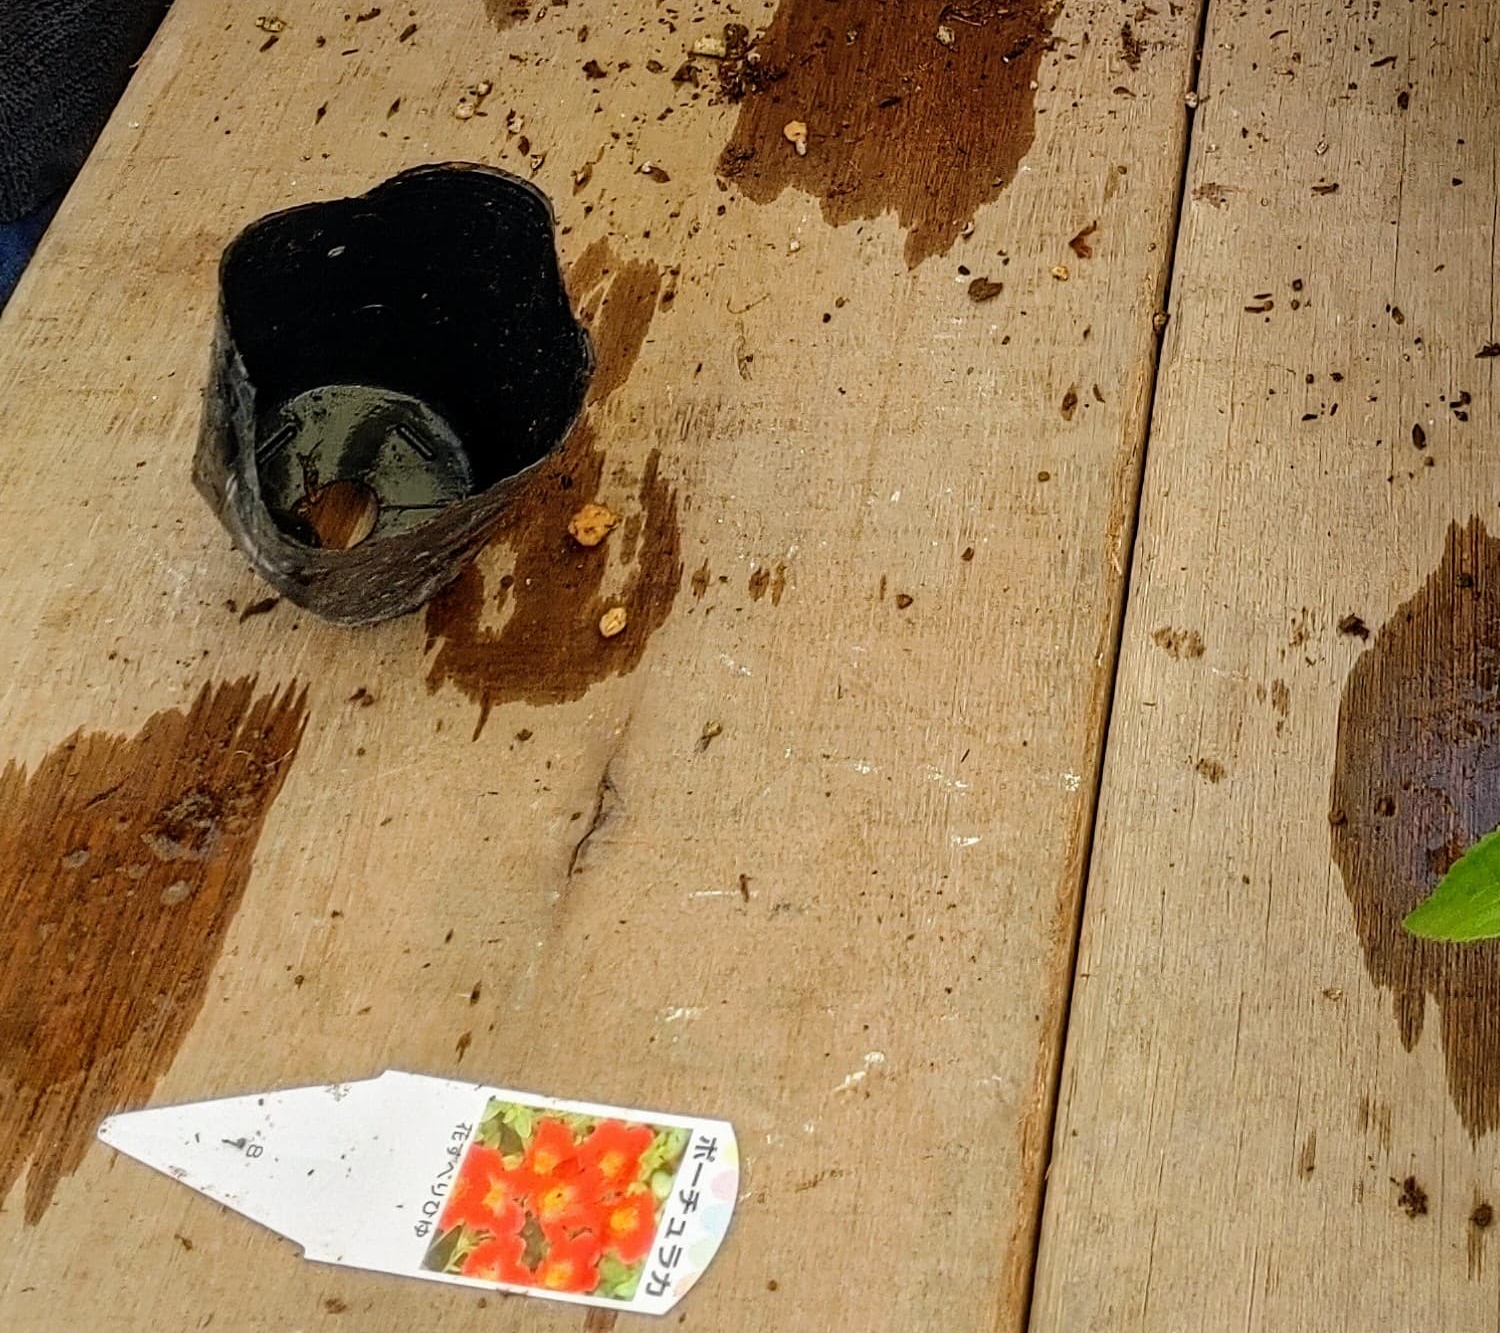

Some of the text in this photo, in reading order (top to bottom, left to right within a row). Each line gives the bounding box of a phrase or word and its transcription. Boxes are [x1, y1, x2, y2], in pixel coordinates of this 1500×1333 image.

[644, 1134, 718, 1297] ポーチュラカ
